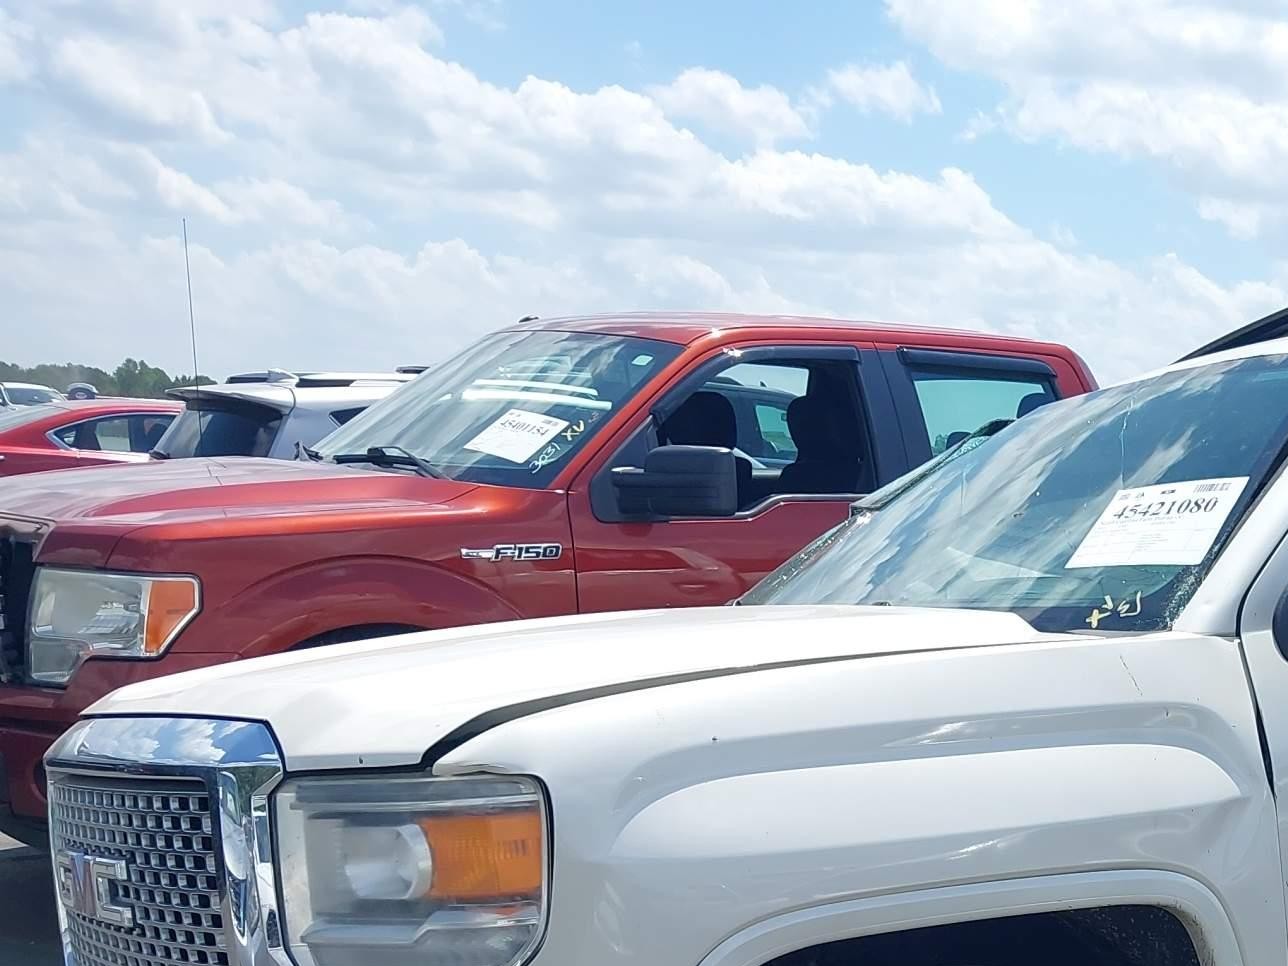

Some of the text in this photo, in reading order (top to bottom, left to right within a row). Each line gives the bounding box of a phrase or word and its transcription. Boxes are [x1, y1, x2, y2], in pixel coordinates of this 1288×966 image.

[501, 419, 549, 437] 45401154
[1113, 496, 1219, 519] 45421080
[491, 543, 562, 561] F-150
[56, 851, 134, 928] GMC
